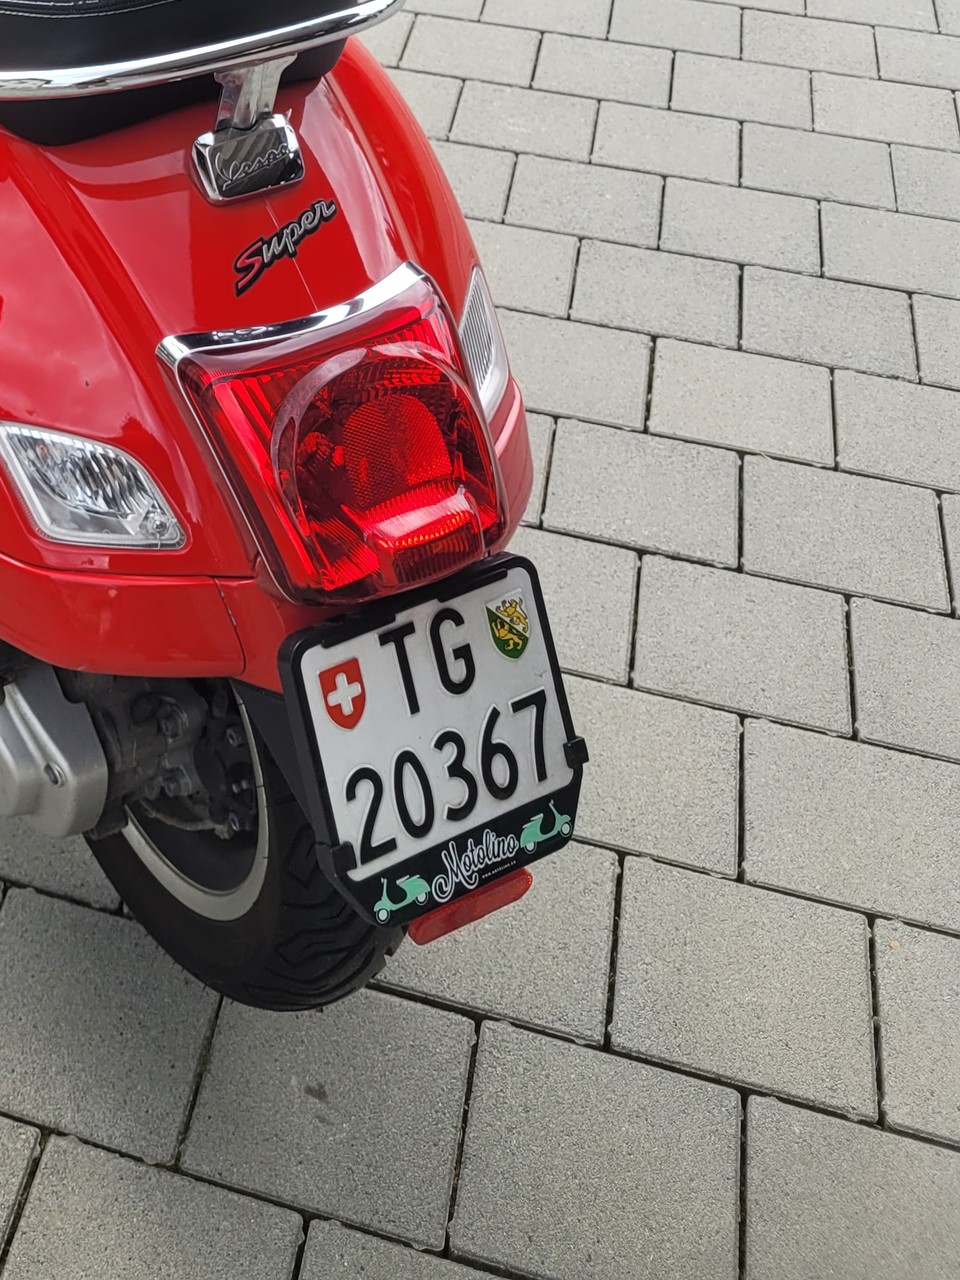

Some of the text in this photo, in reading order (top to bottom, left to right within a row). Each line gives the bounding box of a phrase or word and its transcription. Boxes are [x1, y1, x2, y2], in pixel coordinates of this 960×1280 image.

[215, 143, 292, 191] Vespa
[233, 199, 338, 297] Super
[378, 607, 476, 716] TG
[345, 688, 548, 865] 20367
[432, 828, 520, 903] Motolino
